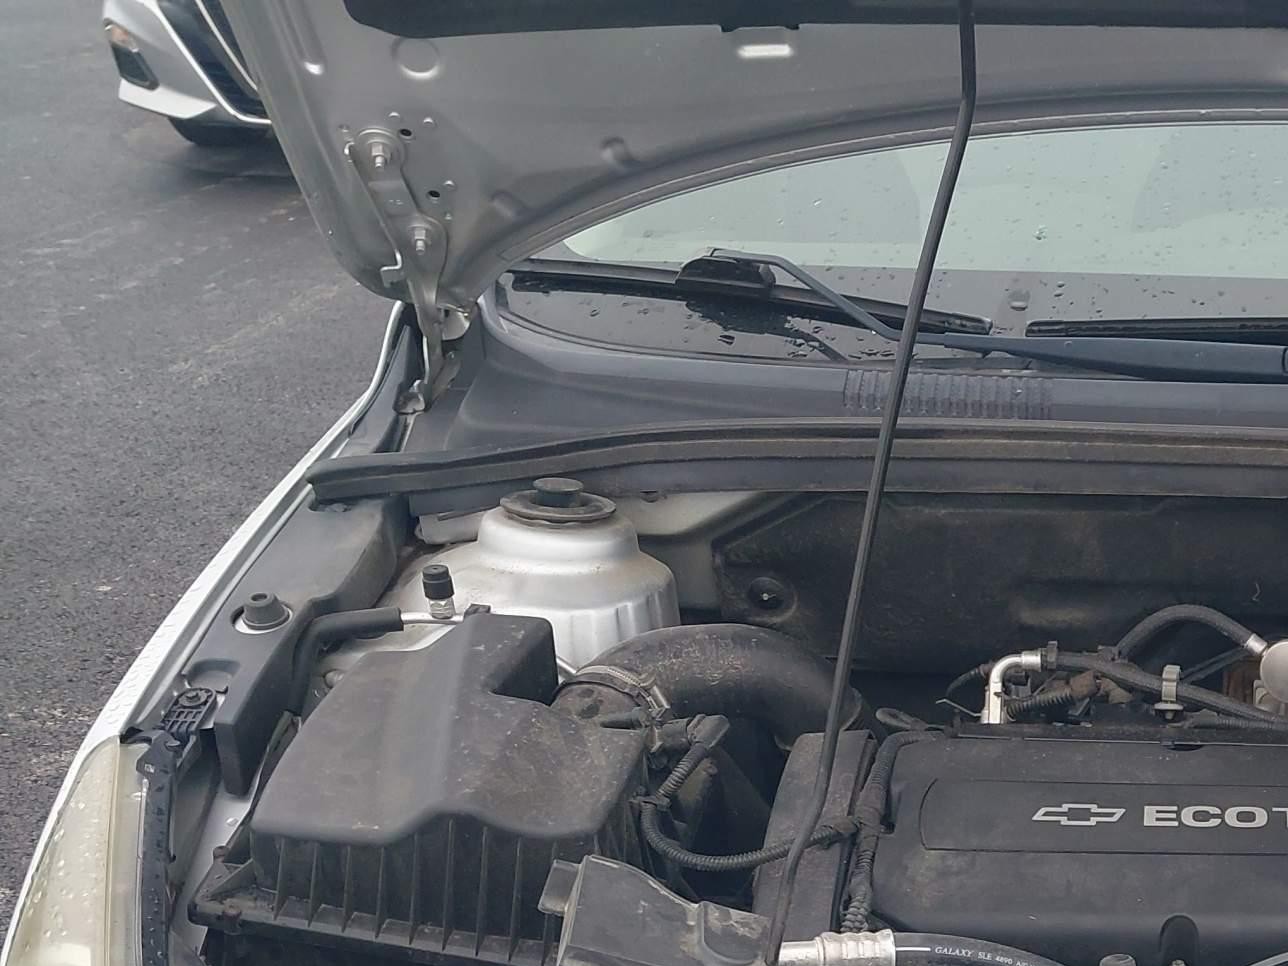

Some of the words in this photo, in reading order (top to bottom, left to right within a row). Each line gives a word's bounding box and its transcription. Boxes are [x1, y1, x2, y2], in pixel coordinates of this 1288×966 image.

[935, 947, 972, 958] GALAXY
[978, 951, 992, 961] SLE
[995, 955, 1013, 965] 4890
